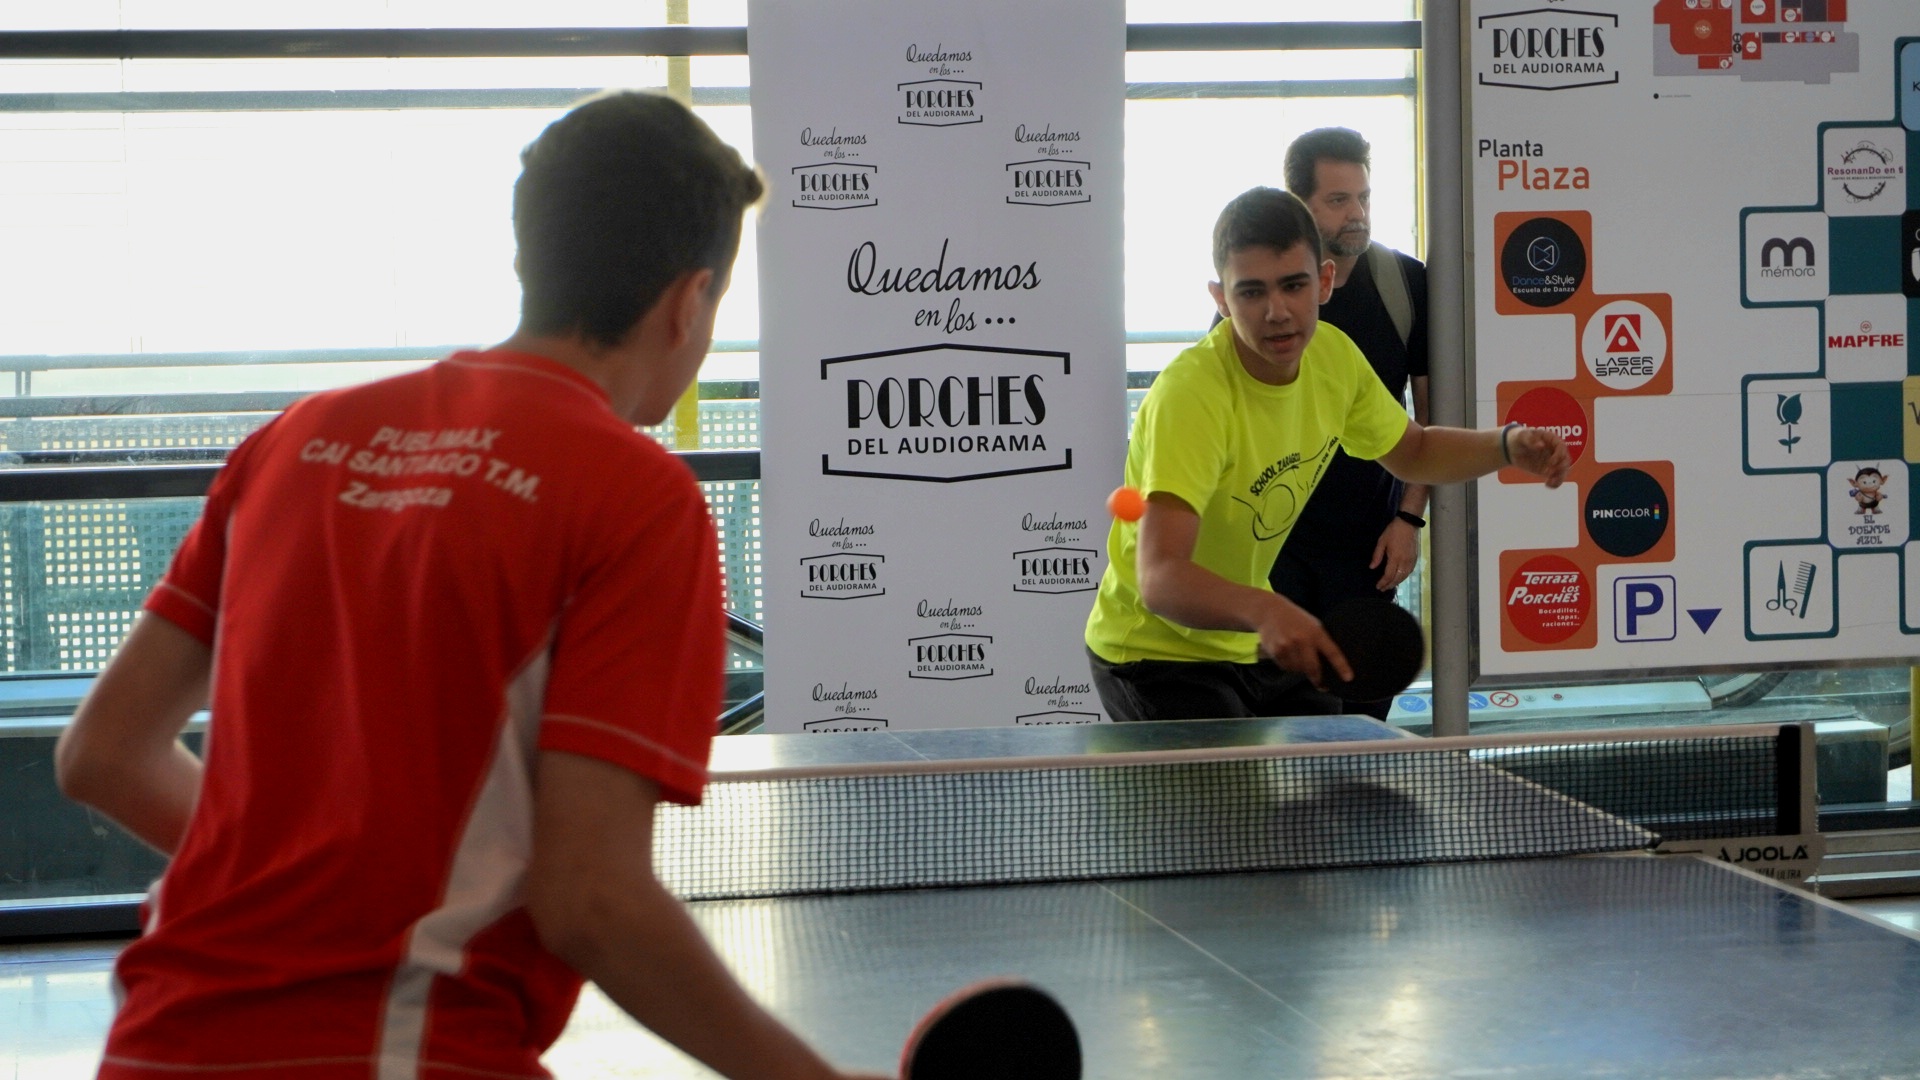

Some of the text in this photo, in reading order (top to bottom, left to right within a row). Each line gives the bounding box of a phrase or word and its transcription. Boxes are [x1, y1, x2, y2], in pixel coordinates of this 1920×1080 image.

[1493, 25, 1605, 59] PORCHES
[906, 43, 973, 63] Quedamos
[928, 67, 939, 75] en
[1493, 61, 1605, 75] DEL AUDIORAMA
[906, 89, 975, 109] PORCHES
[906, 109, 975, 118] DEL AUDIORAMA
[800, 126, 867, 147] Quedamos
[1014, 123, 1081, 144] Quedamos
[823, 150, 834, 158] en
[1477, 139, 1544, 158] Planta
[1498, 159, 1590, 191] Plaza
[1827, 166, 1881, 175] ResonanDo
[800, 173, 870, 192] PORCHES
[1014, 169, 1083, 189] PORCHES
[818, 193, 870, 201] AUDIORAMA
[1031, 190, 1084, 198] AUDIORAMA
[847, 238, 1042, 296] Quedamos
[1761, 263, 1816, 279] mémora
[1512, 274, 1575, 287] Dance&Style
[1512, 286, 1541, 294] Escuela
[1553, 285, 1575, 293] Danza
[914, 305, 942, 326] en
[1828, 333, 1905, 349] MAPFRE
[1595, 356, 1654, 367] LASER
[1595, 365, 1654, 378] SPACE
[846, 374, 1047, 429] PORCHES
[848, 434, 1048, 456] DEL AUDIORAMA
[300, 438, 351, 465] CAI
[348, 450, 482, 477] SANTIAGO
[1250, 465, 1277, 496] SCHOOL
[1592, 506, 1651, 519] PINCOLOR
[1863, 515, 1875, 524] EL
[808, 517, 875, 538] Quedamos
[1022, 512, 1088, 532] Quedamos
[1848, 524, 1891, 535] DUENDE
[831, 540, 842, 548] en
[1044, 534, 1055, 542] en
[1856, 535, 1883, 545] AZUL
[808, 562, 877, 582] PORCHES
[1022, 557, 1090, 577] PORCHES
[1038, 577, 1090, 585] AUDIORAMA
[1521, 571, 1580, 585] Terraza
[809, 583, 877, 592] DEL AUDIORAMA
[1561, 585, 1580, 593] LOS
[1507, 586, 1580, 606] PORCHES
[916, 598, 983, 619] Quedamos
[940, 621, 950, 629] en
[917, 643, 985, 663] PORCHES
[917, 663, 986, 672] DEL AUDIORAMA
[811, 681, 878, 702] Quedamos
[1024, 676, 1092, 696] Quedamos
[834, 704, 845, 712] en
[1047, 698, 1057, 706] en
[1734, 845, 1809, 863] JOOLA
